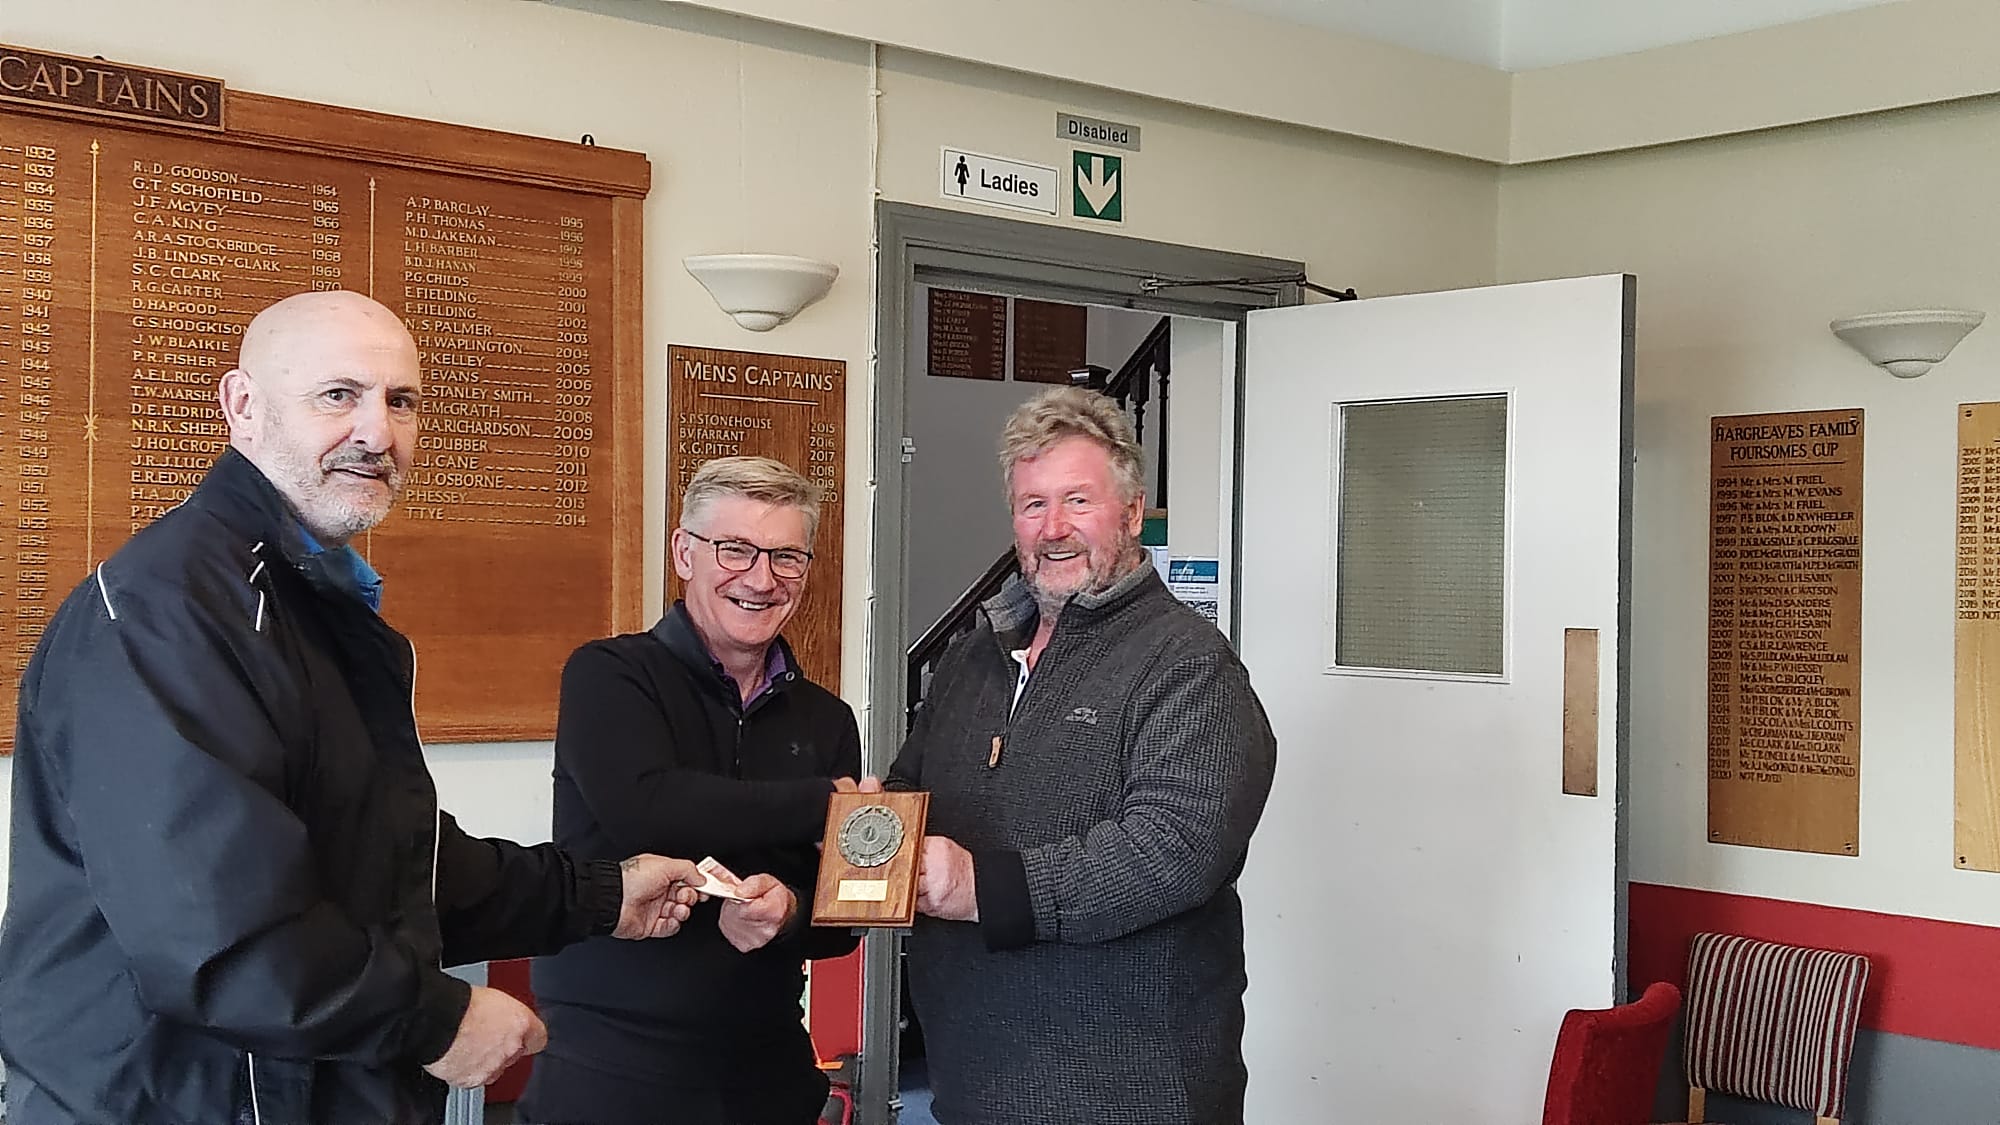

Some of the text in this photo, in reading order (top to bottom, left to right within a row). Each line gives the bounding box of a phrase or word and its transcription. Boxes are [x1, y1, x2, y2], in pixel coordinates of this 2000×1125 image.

[0, 56, 208, 118] CAPTAINS
[1068, 120, 1128, 144] Disabled
[24, 146, 55, 160] 1932
[24, 163, 54, 177] 1933
[171, 165, 238, 184] GOODSON
[312, 184, 337, 196] 1964
[980, 168, 1039, 197] Ladies
[24, 181, 55, 195] 1934
[170, 182, 262, 204] SCHOFIELD
[313, 200, 338, 213] 1965
[24, 199, 53, 212] 1935
[434, 199, 490, 217] BARCLAY
[560, 216, 583, 228] 1995
[24, 216, 53, 230] 1936
[313, 216, 339, 229] 1966
[432, 215, 485, 231] THOMAS
[560, 231, 583, 243] 1996
[24, 234, 53, 247] 1937
[312, 233, 339, 246] 1967
[431, 228, 496, 246] JAKEMAN
[23, 251, 51, 264] 1938
[312, 249, 340, 262] 1968
[165, 250, 280, 271] LINDSEY-CLARK
[311, 265, 340, 278] 1969
[23, 269, 51, 282] 1939
[170, 267, 221, 282] CLARK
[22, 288, 51, 300] 1940
[558, 286, 587, 298] 2000
[22, 305, 49, 317] 1941
[557, 301, 586, 314] 2001
[22, 322, 51, 336] 1942
[556, 316, 587, 329] 2002
[435, 321, 492, 336] PALMER
[556, 332, 588, 343] 2003
[22, 340, 50, 352] 1943
[433, 337, 523, 354] WAPLINGTON
[21, 358, 49, 371] 1944
[555, 363, 591, 375] 2005
[21, 376, 50, 388] 1945
[684, 361, 833, 391] MENS CAPTAINS
[555, 379, 592, 391] 2006
[20, 393, 49, 406] 1946
[493, 389, 533, 403] SMITH
[555, 394, 592, 406] 2007
[20, 411, 50, 422] 1947
[554, 410, 593, 424] 2008
[553, 426, 593, 440] 2009
[811, 423, 835, 434] 2015
[1714, 418, 1860, 442] HARGREAVES FAMILY
[810, 436, 834, 448] 2016
[554, 445, 591, 458] 2010
[810, 450, 835, 462] 2017
[1730, 443, 1839, 461] FOURSOMES CUP
[555, 462, 587, 476] 2011
[809, 466, 835, 476] 2018
[555, 479, 588, 493] 2012
[1796, 475, 1825, 485] FRIEL
[554, 497, 585, 509] 2013
[1796, 500, 1825, 509] FRIEL
[554, 514, 587, 526] 2014
